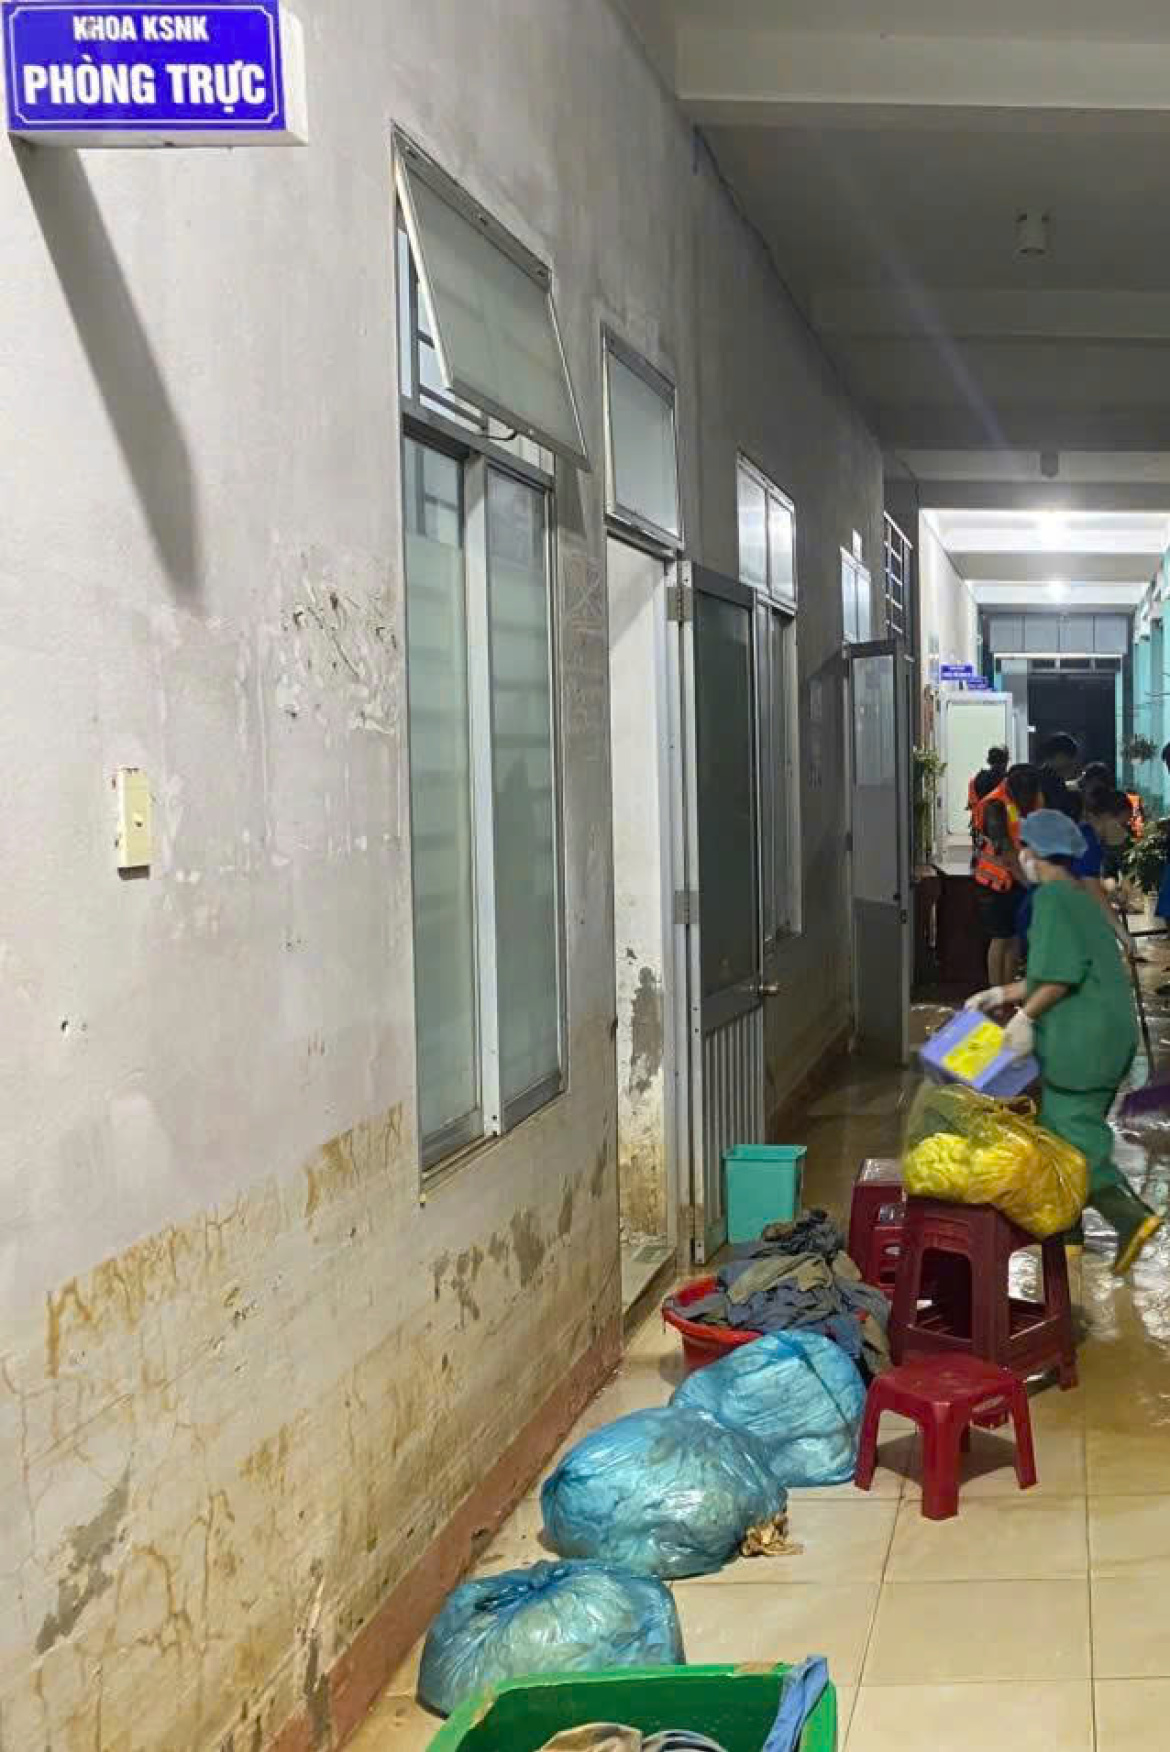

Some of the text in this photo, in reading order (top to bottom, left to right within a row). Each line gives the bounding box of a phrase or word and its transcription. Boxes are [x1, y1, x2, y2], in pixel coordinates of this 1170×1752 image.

[73, 15, 209, 41] KHOA KSNK
[23, 53, 266, 113] PHÒNG TRỰC
